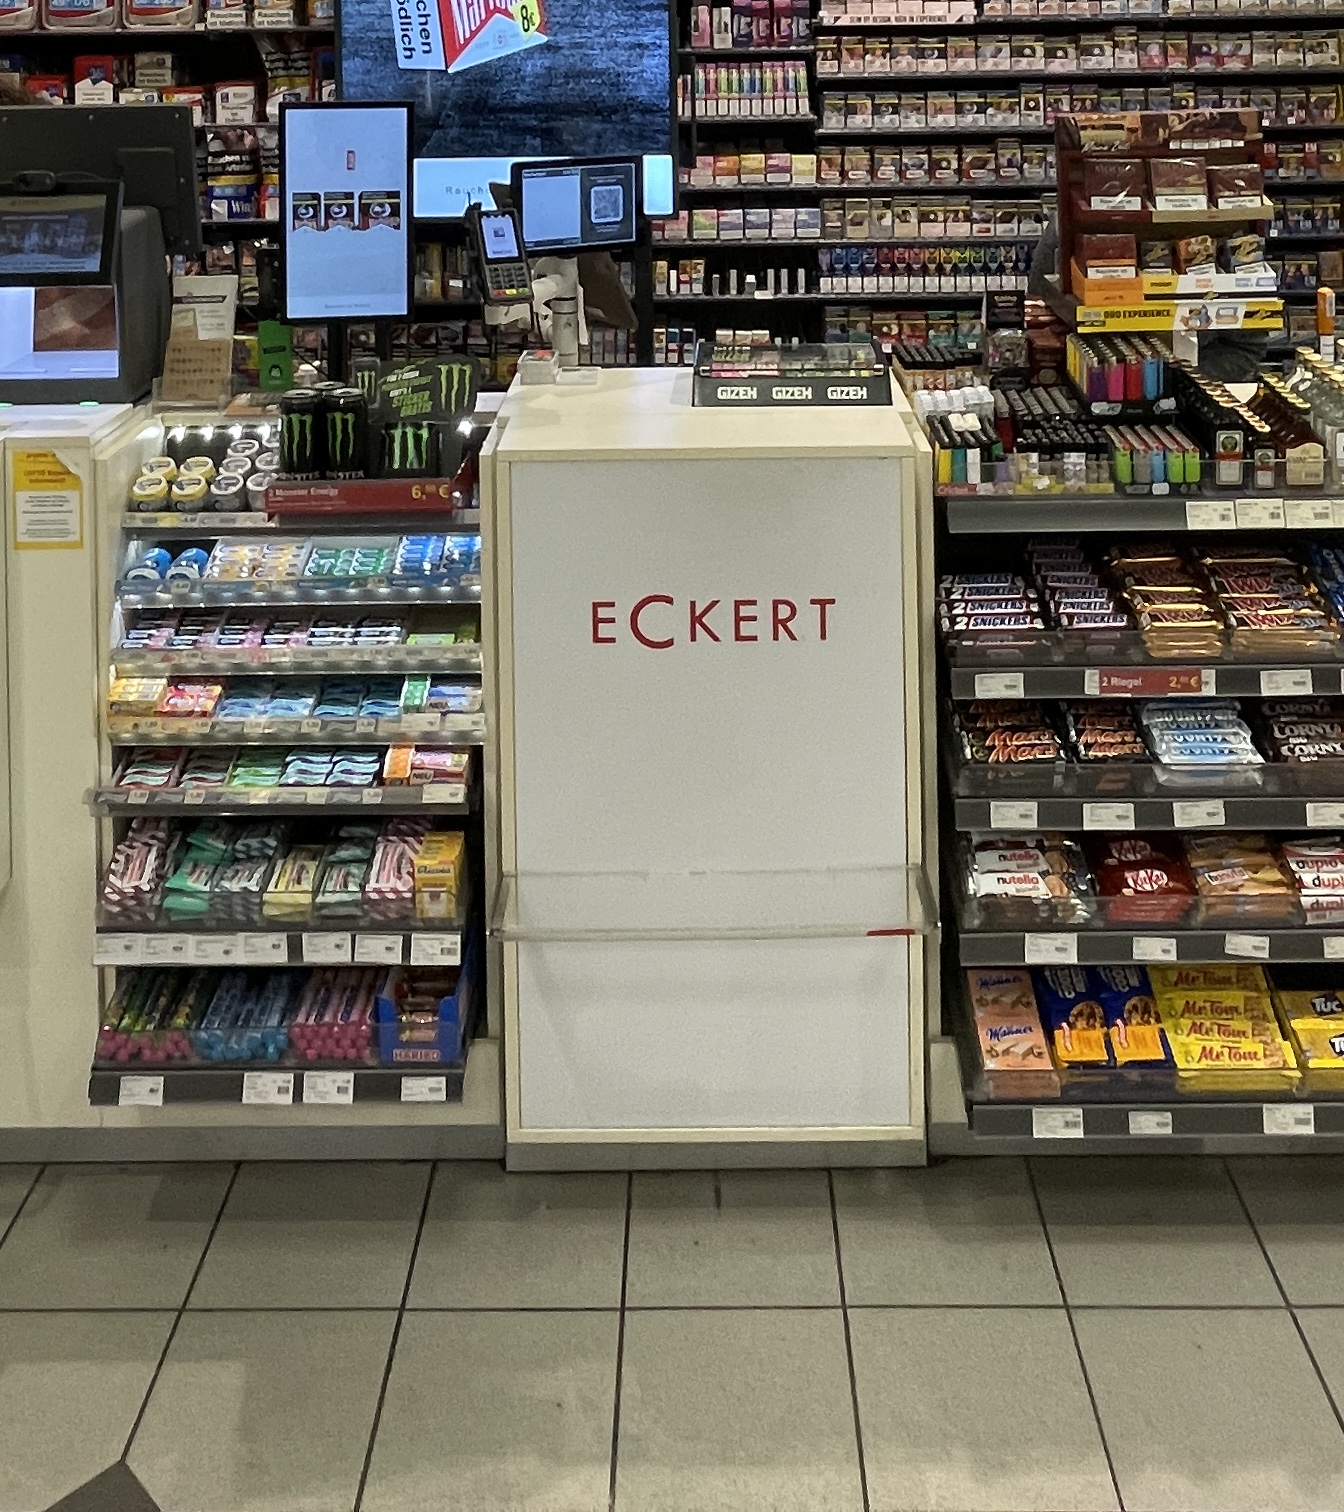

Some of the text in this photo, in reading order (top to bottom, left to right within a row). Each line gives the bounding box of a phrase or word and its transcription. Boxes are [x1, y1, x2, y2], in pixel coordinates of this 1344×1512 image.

[717, 386, 867, 400] GIZEH GIZEH GIZEH
[952, 588, 963, 598] 2
[953, 601, 1024, 613] 2 SNICKERS
[1063, 602, 1111, 611] SNICKERS
[592, 594, 836, 649] ECKERT
[955, 615, 1029, 629] 2 SNICKERS
[1076, 615, 1126, 624] SNICKERS
[1102, 677, 1108, 686] 2
[1111, 676, 1142, 689] Riegel
[985, 729, 1056, 746] Mars
[1078, 729, 1137, 744] Mars
[1274, 724, 1340, 738] CORNY
[989, 745, 1056, 764] Mars
[413, 771, 432, 781] NEU
[998, 851, 1040, 862] nutella
[1296, 858, 1338, 872] duplo
[996, 875, 1040, 885] nutella
[1133, 872, 1167, 888] KitKat
[1181, 1001, 1242, 1017] Mr Tom
[986, 1026, 1033, 1040] Manner
[1188, 1022, 1250, 1038] Mr Tom
[394, 1050, 439, 1061] HARIBO
[1197, 1045, 1262, 1063] Mr Tom
